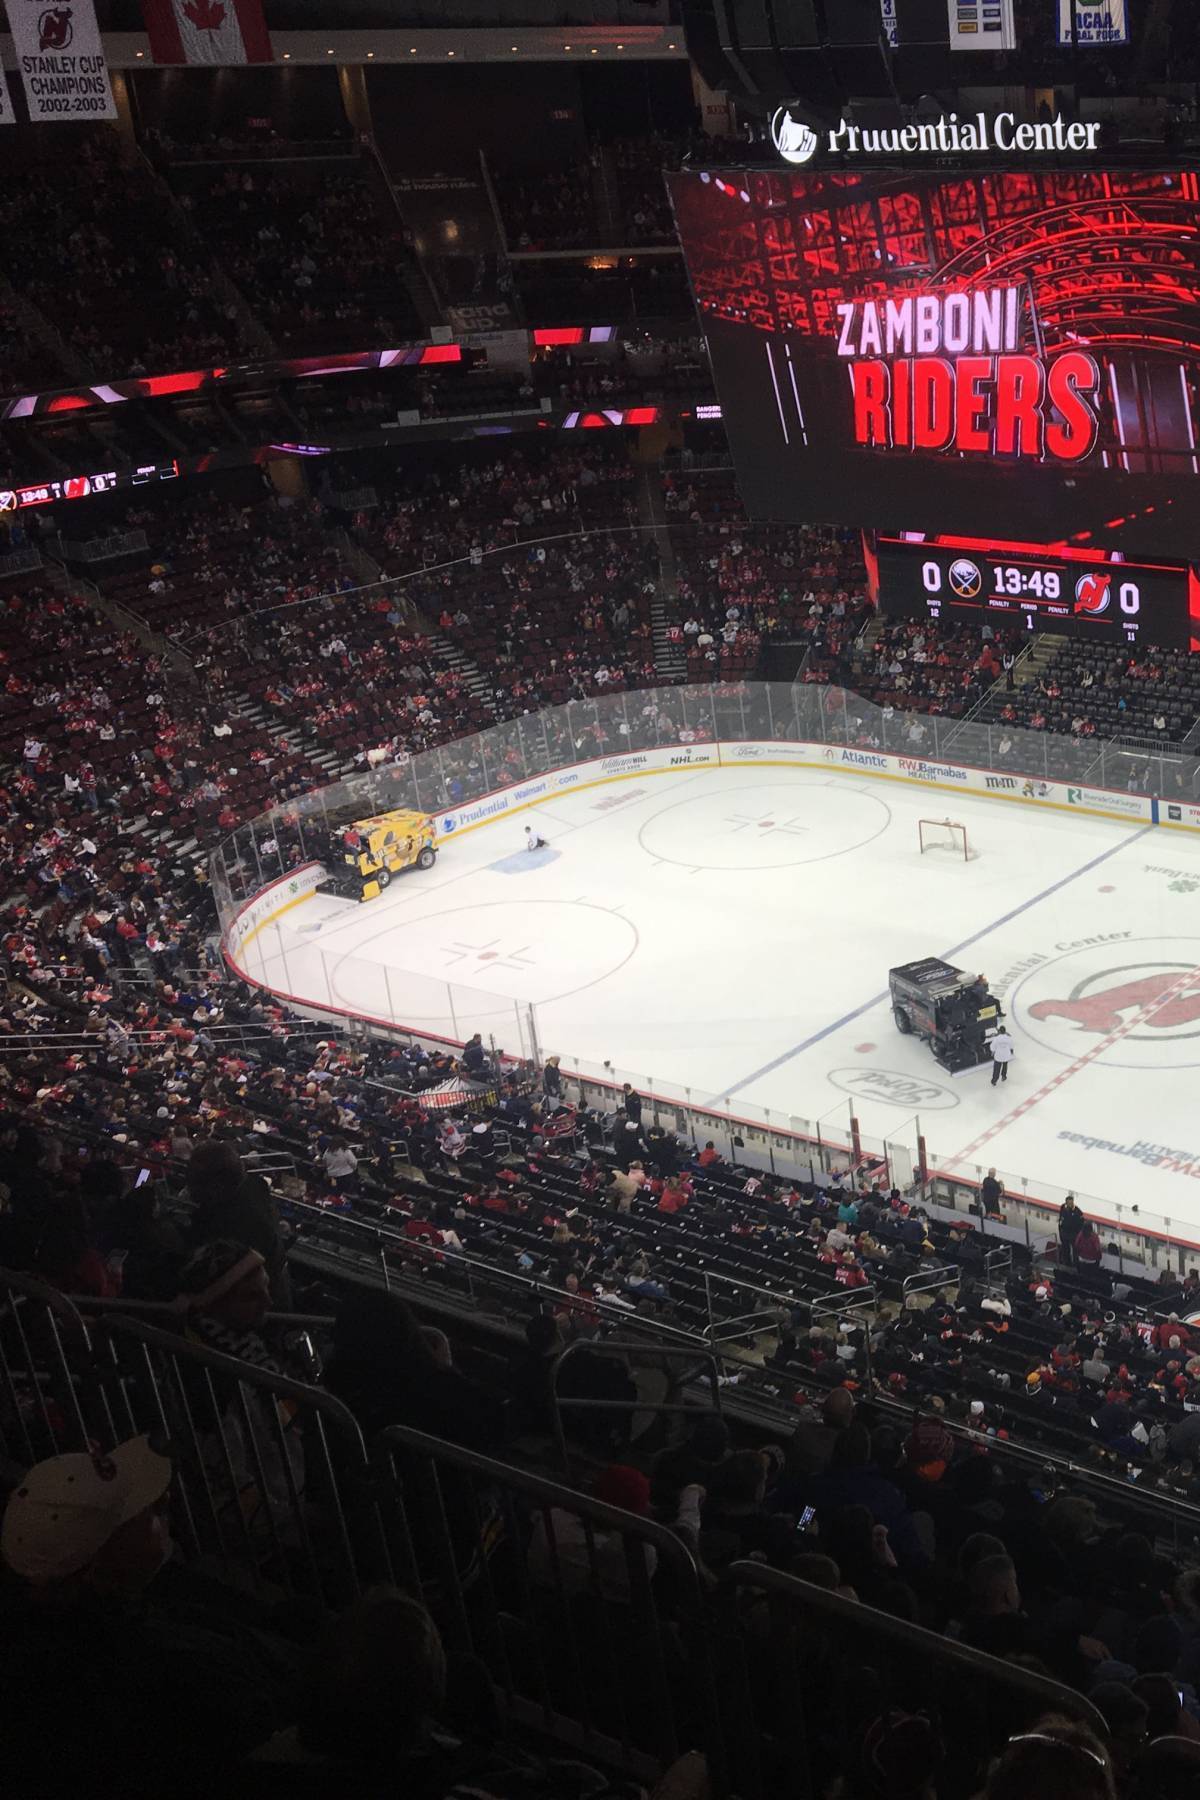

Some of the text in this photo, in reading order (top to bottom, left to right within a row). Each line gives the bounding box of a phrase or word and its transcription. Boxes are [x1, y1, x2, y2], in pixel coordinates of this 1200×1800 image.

[22, 55, 105, 73] STANLEY CUP
[31, 76, 106, 95] CHAMPIONS
[38, 98, 107, 112] 2002-2003
[993, 112, 1101, 151] Center
[837, 287, 1018, 356] ZAMBONI
[853, 352, 1098, 460] RIDERS
[20, 488, 49, 503] 13:49
[922, 561, 941, 592] 0
[993, 566, 1060, 598] 13:49
[988, 600, 1010, 608] PENALTY
[1020, 602, 1038, 611] PERIOD
[1119, 582, 1139, 614] 0
[1048, 606, 1069, 615] PENALTY
[1027, 615, 1034, 630] 1
[841, 750, 887, 768] Atlantic
[899, 759, 967, 780] RWJBarnabas
[908, 770, 937, 782] HEALTH
[513, 783, 547, 801] Walmart
[460, 797, 509, 825] Prudential
[1054, 930, 1133, 951] Center
[847, 1072, 942, 1104] Ford
[1133, 1140, 1200, 1163] HEALTH
